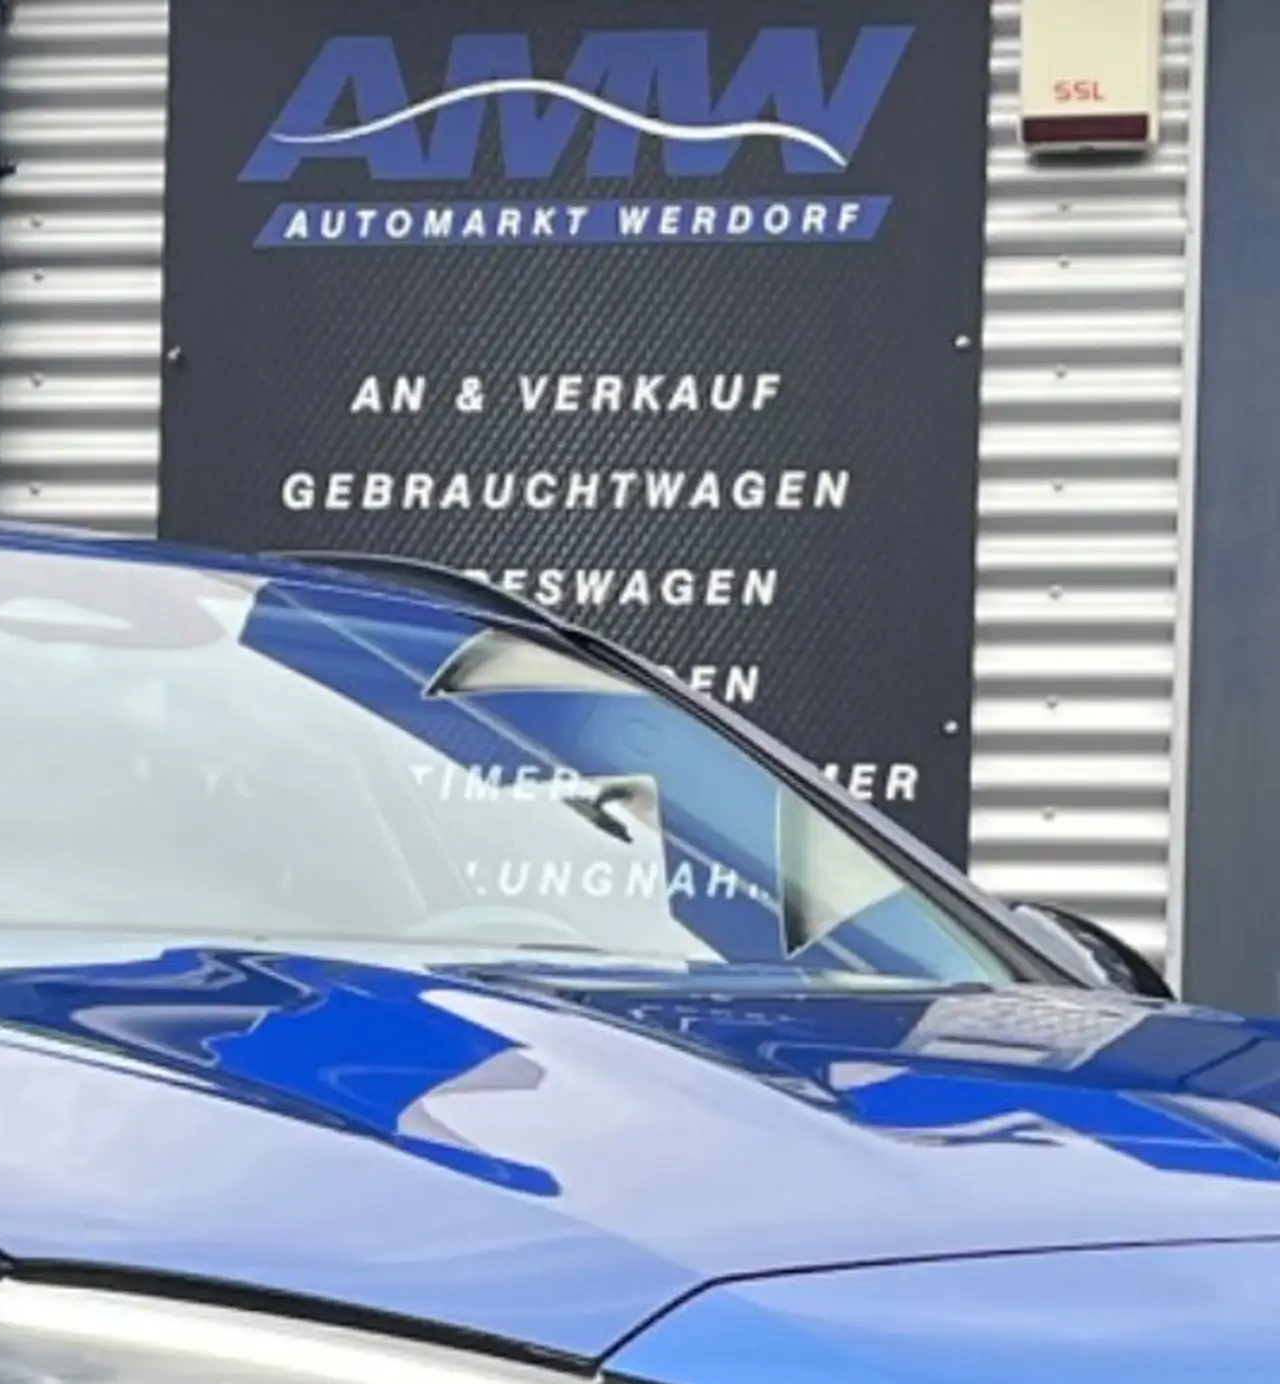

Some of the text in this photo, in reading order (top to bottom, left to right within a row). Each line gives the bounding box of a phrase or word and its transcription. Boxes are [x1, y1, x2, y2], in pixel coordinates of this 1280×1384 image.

[237, 25, 916, 182] AMW
[283, 202, 862, 240] AUTOMARKT WERDORF
[351, 374, 781, 413] AN & VERKAUF
[282, 470, 850, 511] GEBRAUCHTWAGEN
